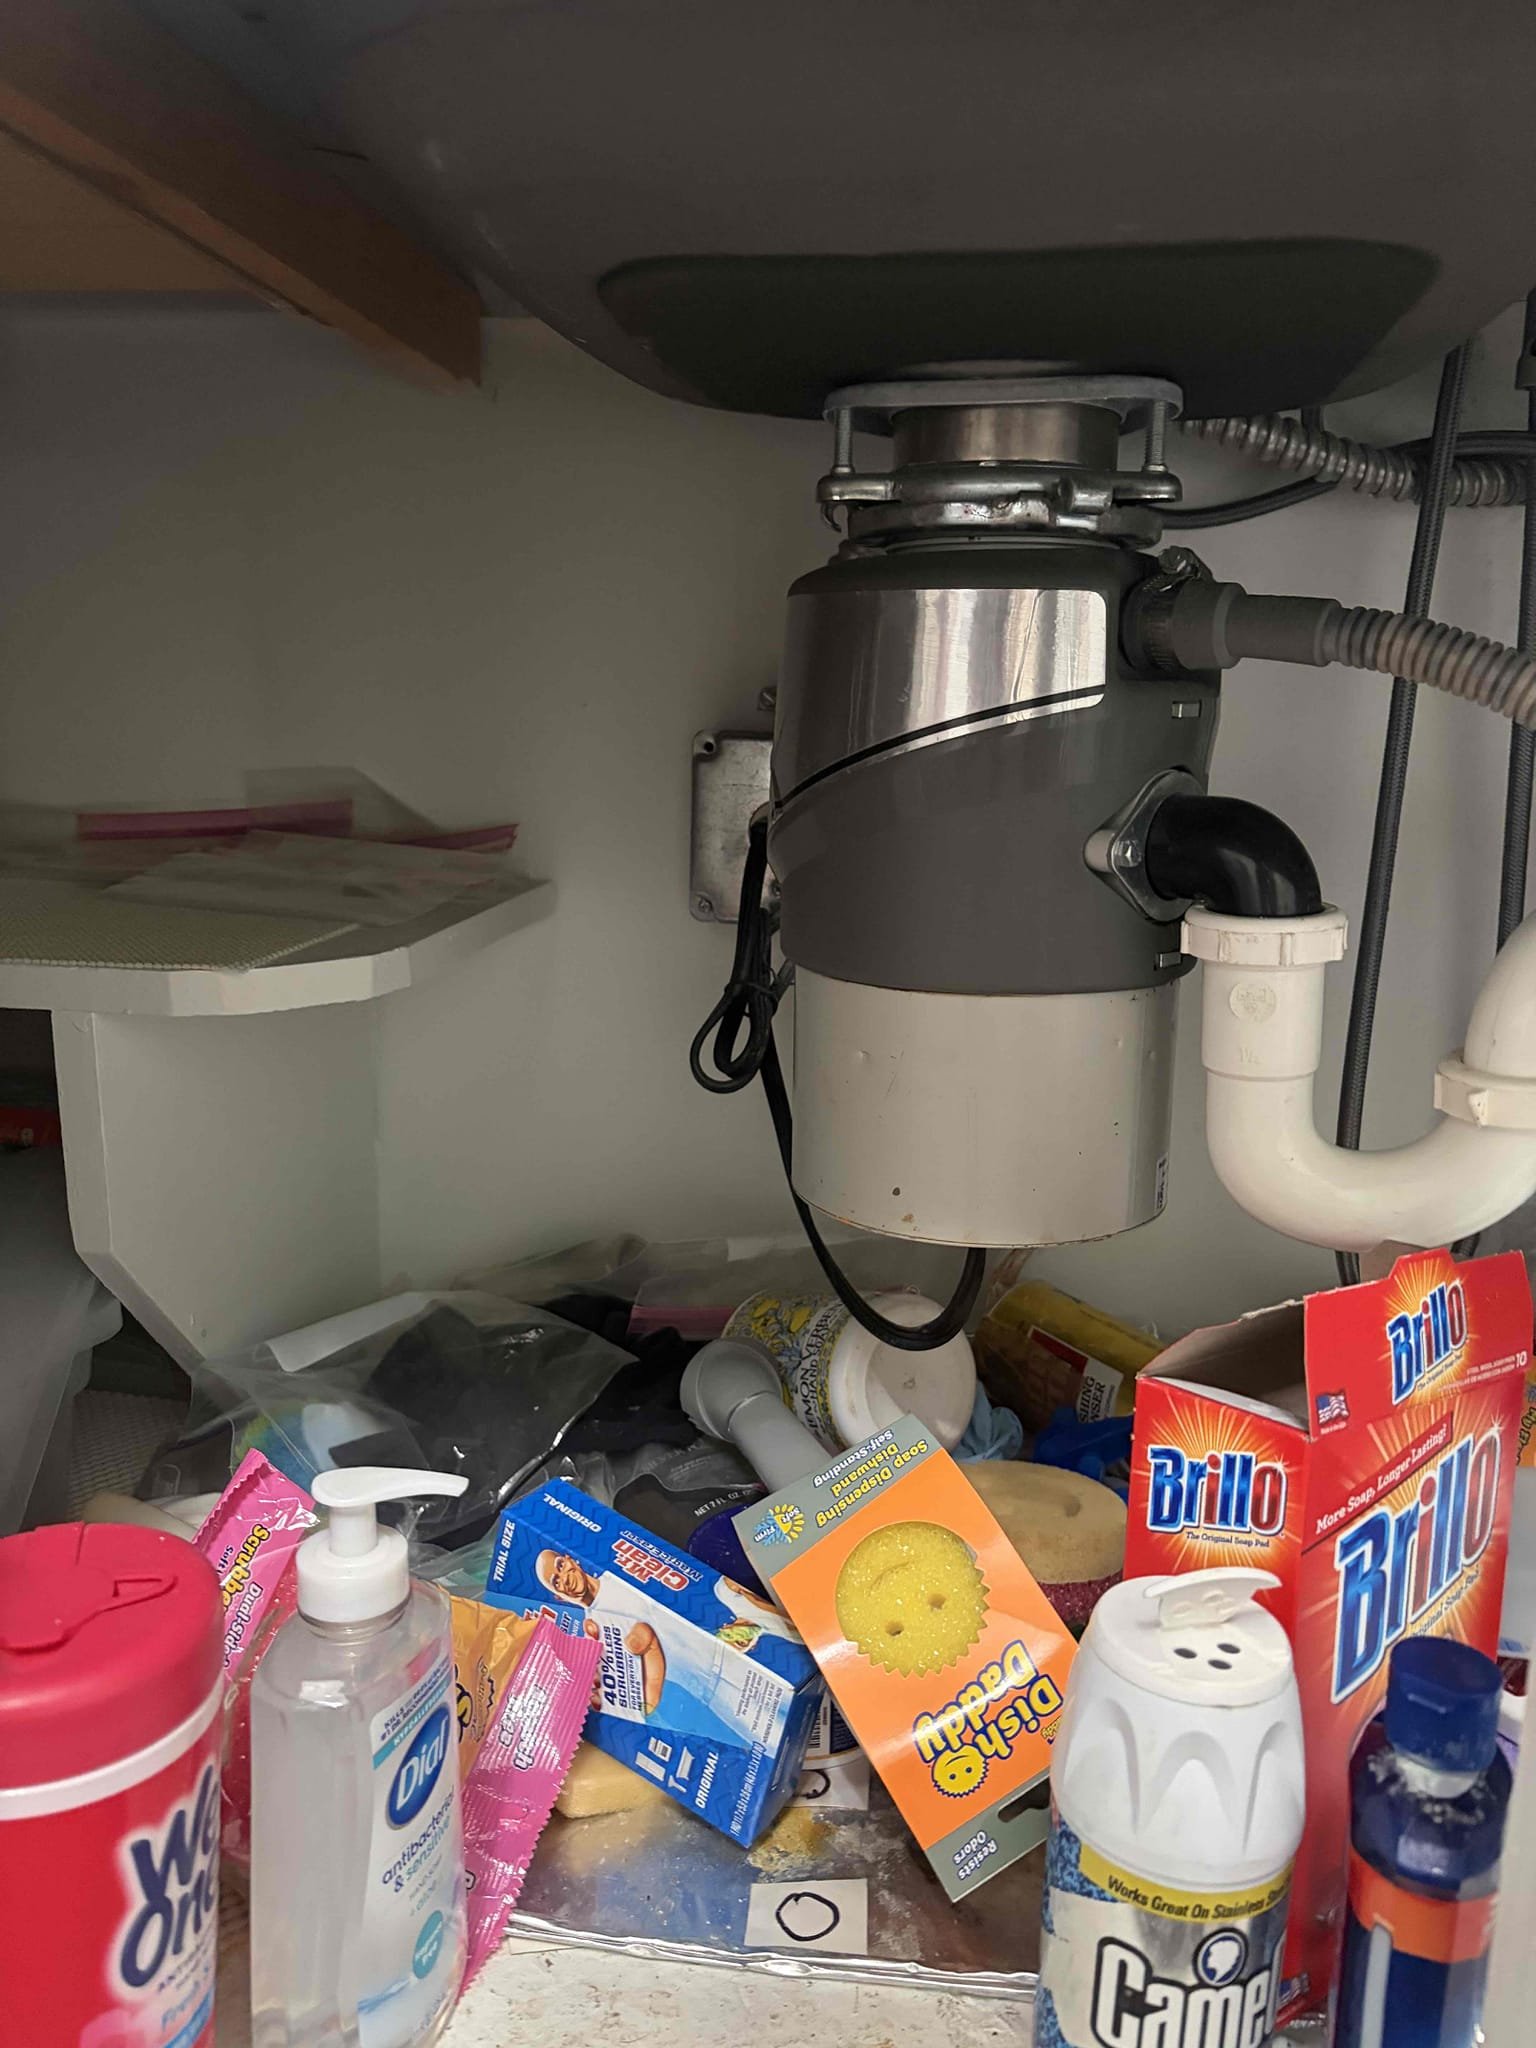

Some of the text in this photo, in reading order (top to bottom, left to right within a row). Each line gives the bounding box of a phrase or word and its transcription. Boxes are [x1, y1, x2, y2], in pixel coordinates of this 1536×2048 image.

[1386, 1280, 1467, 1405] Brillo
[1516, 1350, 1528, 1368] 10
[813, 1429, 894, 1487] Self-Standing
[815, 1439, 928, 1528] Soap Dispensing
[831, 1443, 899, 1497] Dishwand
[543, 1492, 602, 1533] ORIGINAL
[782, 1507, 801, 1524] Soft
[1147, 1444, 1288, 1535] Brillo
[1315, 1508, 1346, 1535] More
[1347, 1487, 1376, 1512] Soap,
[1377, 1457, 1411, 1492] Longer
[219, 1545, 233, 1570] Soft
[493, 1520, 516, 1583] TRIAL SIZE
[754, 1526, 775, 1542] Firm
[1186, 1531, 1270, 1547] The Original Soap Pad
[611, 1538, 689, 1592] Clean
[614, 1553, 652, 1584] Mr.
[1331, 1429, 1501, 1705] Brillo
[1412, 1602, 1444, 1637] riginal
[600, 1626, 617, 1706] 40% LESS
[611, 1627, 627, 1709] SCRUBBING
[913, 1640, 1039, 1763] Daddy
[973, 1674, 1063, 1760] Dish
[397, 1715, 449, 1811] Dial
[694, 1751, 720, 1809] ORIGINAL
[130, 1764, 219, 1887] We
[394, 1874, 405, 1892] &
[405, 1815, 450, 1881] sensitive
[953, 1830, 987, 1866] Odors
[958, 1840, 997, 1880] Resists
[120, 1850, 217, 1988] One
[1108, 1874, 1149, 1906] Works
[1151, 1896, 1189, 1917] Great
[1191, 1904, 1210, 1919] On
[1093, 1936, 1287, 2047] Came
